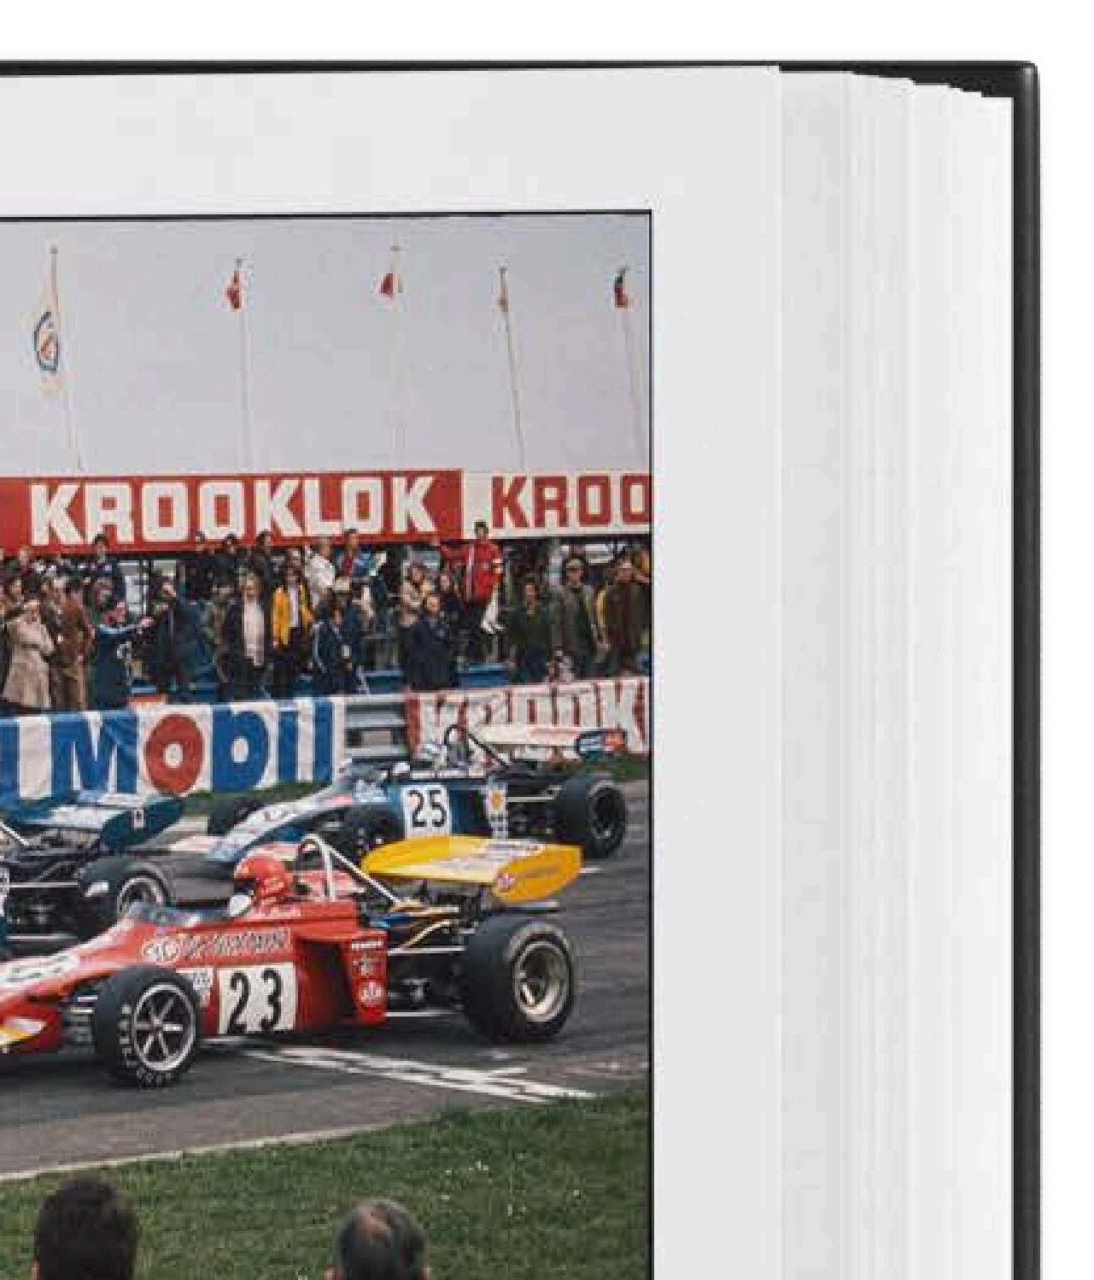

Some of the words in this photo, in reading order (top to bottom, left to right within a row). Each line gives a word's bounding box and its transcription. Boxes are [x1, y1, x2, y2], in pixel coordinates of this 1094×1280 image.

[30, 476, 439, 545] KROOKLOK
[492, 474, 649, 528] KROO
[50, 699, 333, 797] Mobil
[407, 789, 447, 828] 25
[227, 967, 283, 1034] 23
